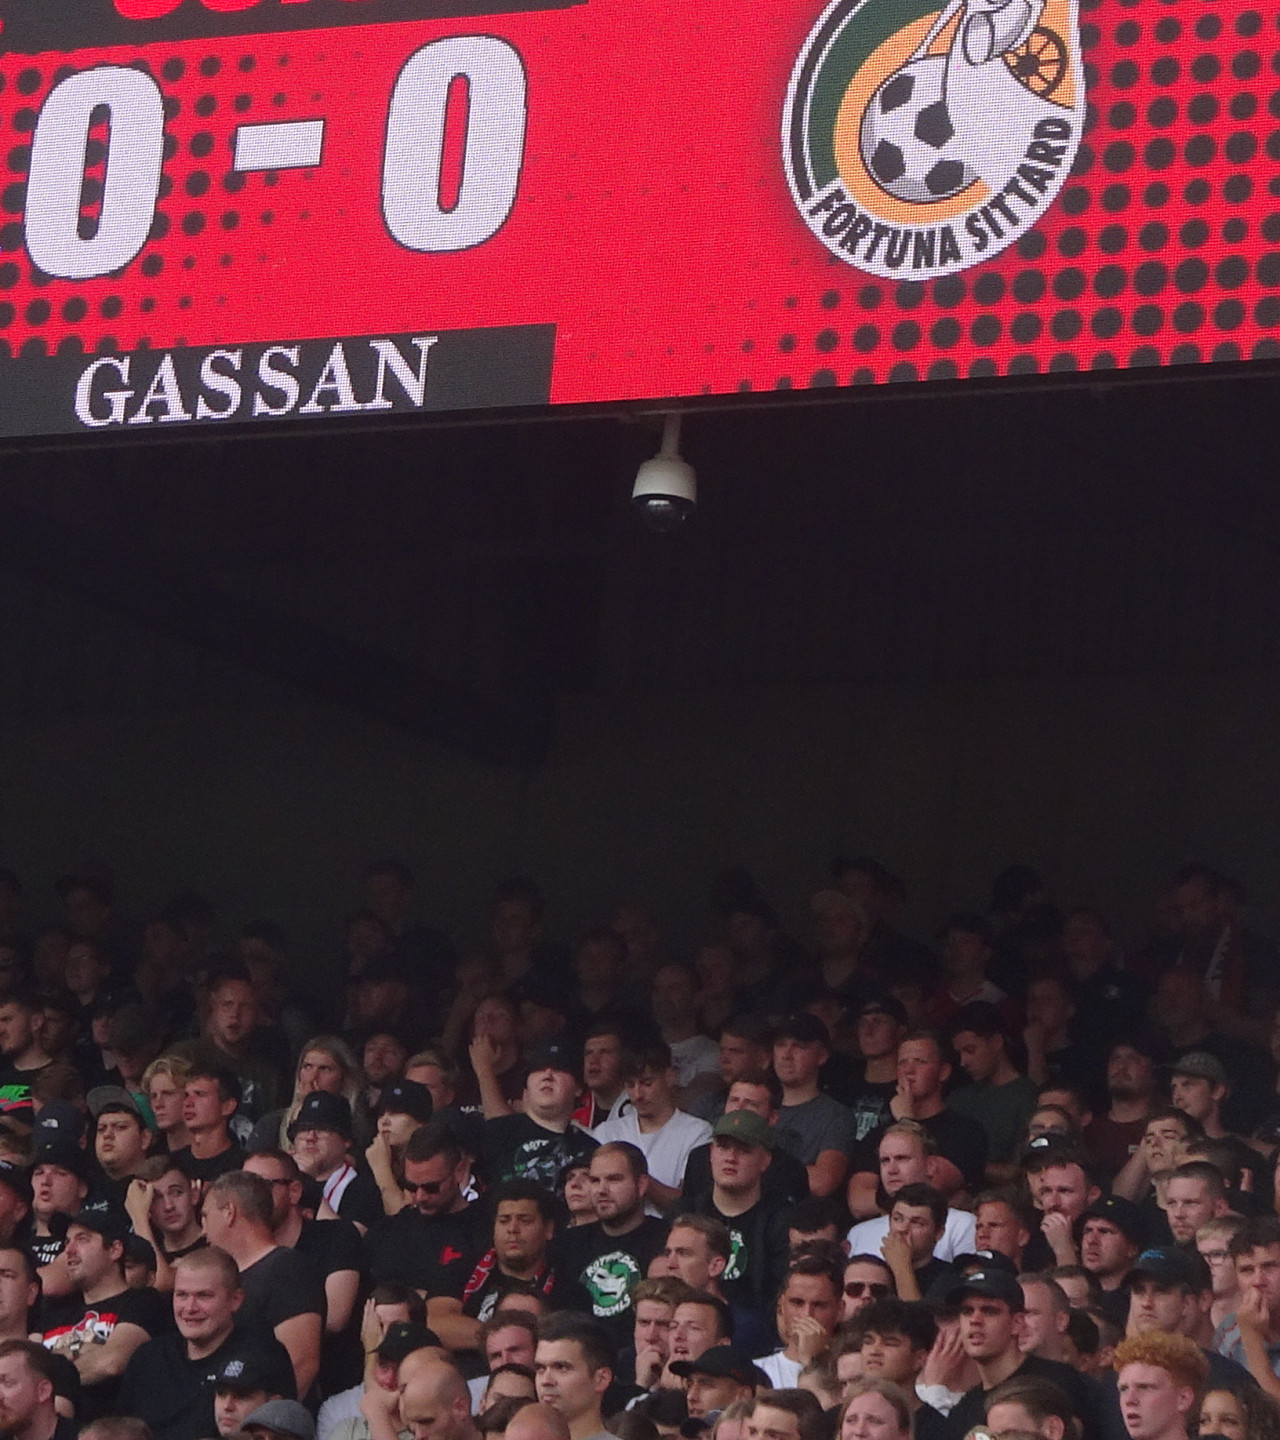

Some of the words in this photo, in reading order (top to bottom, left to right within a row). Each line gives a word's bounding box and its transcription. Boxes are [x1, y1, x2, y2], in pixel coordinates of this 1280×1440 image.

[23, 65, 165, 280] 0
[380, 34, 528, 254] 0
[808, 188, 962, 269] FORTUNA
[966, 118, 1072, 253] SITTARD
[74, 335, 439, 428] GASSAN
